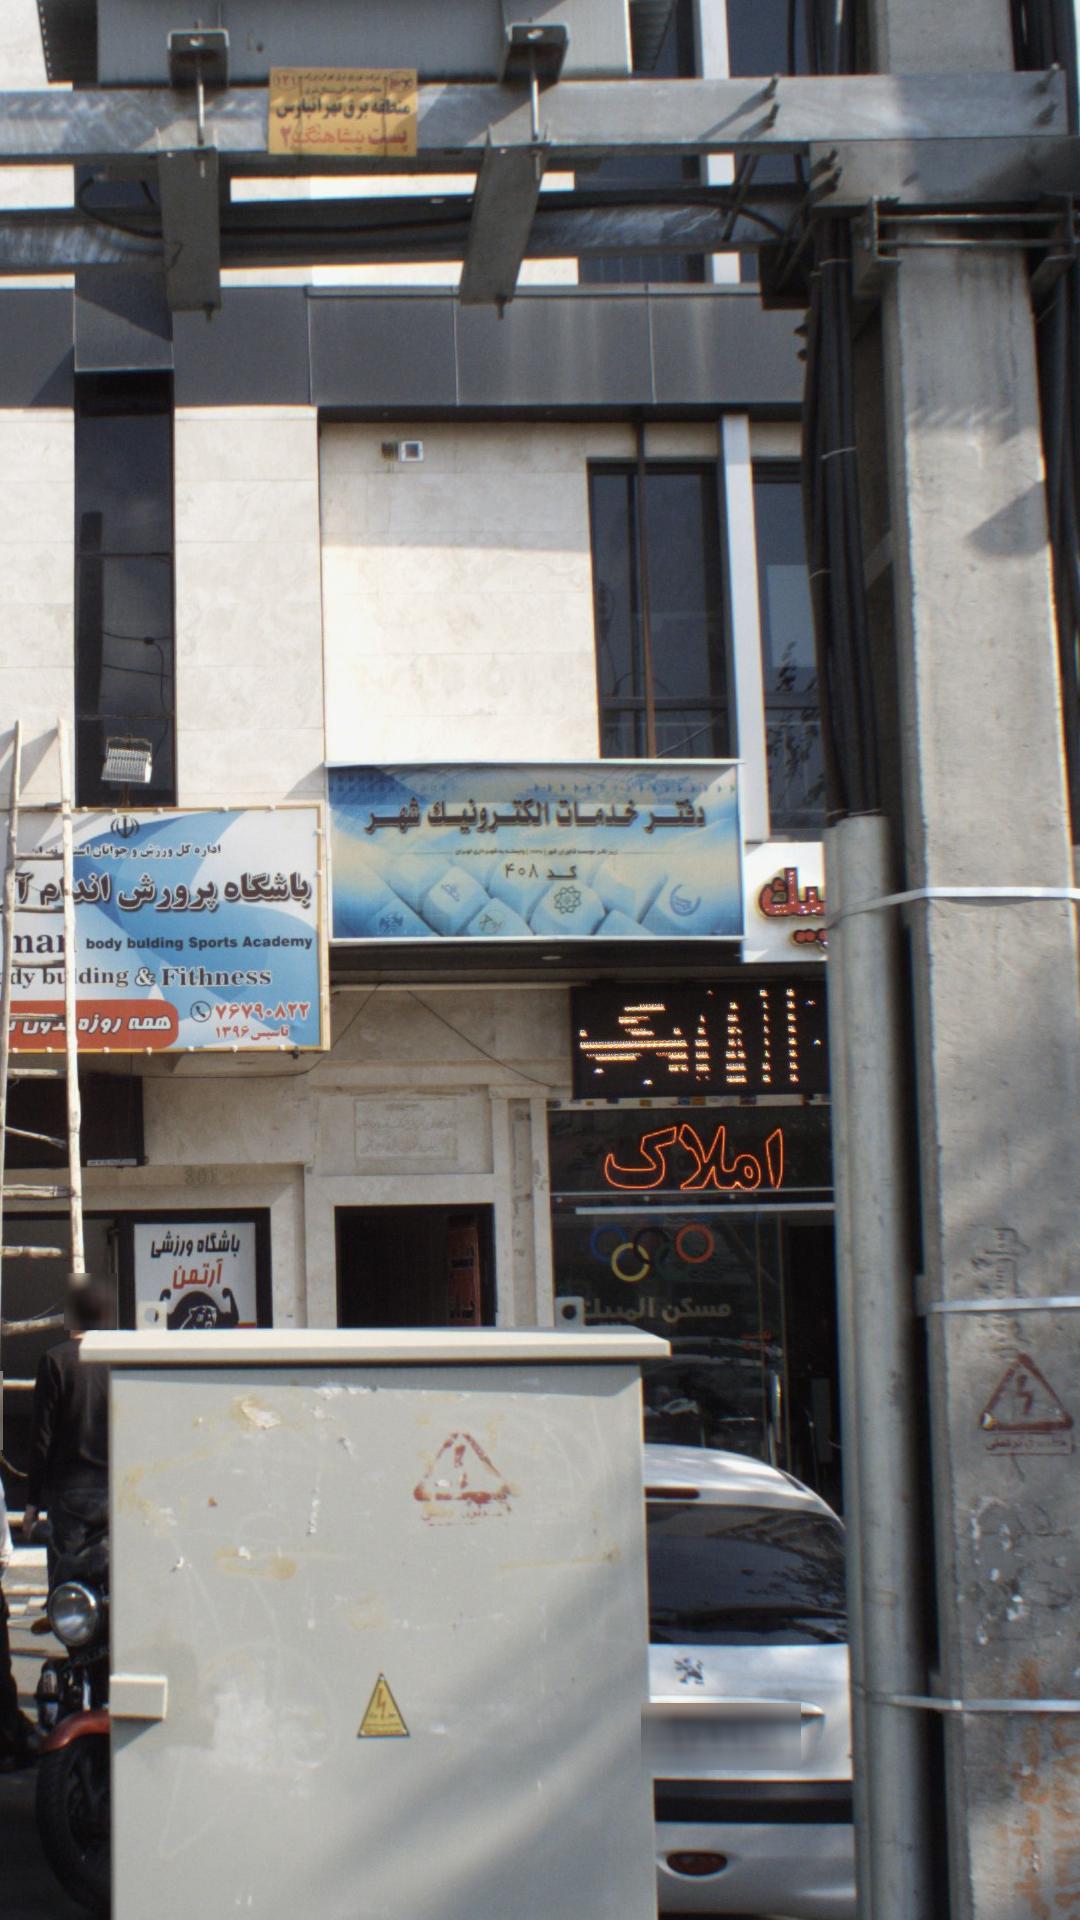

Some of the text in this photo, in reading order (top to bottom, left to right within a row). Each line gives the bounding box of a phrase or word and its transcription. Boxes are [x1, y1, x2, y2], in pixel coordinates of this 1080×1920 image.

[343, 99, 369, 119] برق
[368, 128, 408, 152] پست
[364, 796, 706, 835] دفتر خدمات الکترونیک شهر
[93, 844, 130, 859] جوانان
[131, 848, 138, 858] و
[140, 845, 173, 859] ورزش
[175, 844, 191, 857] کل
[194, 844, 221, 858] اداره
[504, 863, 577, 880] کد ۴۰۸
[117, 874, 220, 914] پرورش
[224, 872, 311, 908] باشگاه
[86, 935, 313, 952] body bulding Sports Academy
[134, 966, 156, 988] &
[161, 965, 273, 987] Fithness
[77, 1013, 122, 1034] روزه
[127, 1014, 172, 1031] همه
[216, 1025, 249, 1039] ۱۳۹۶
[603, 1123, 784, 1191] املاک
[150, 1229, 240, 1258] باشگاه ورزشی
[172, 1258, 224, 1289] آرتمن
[660, 1297, 732, 1323] مسکن
